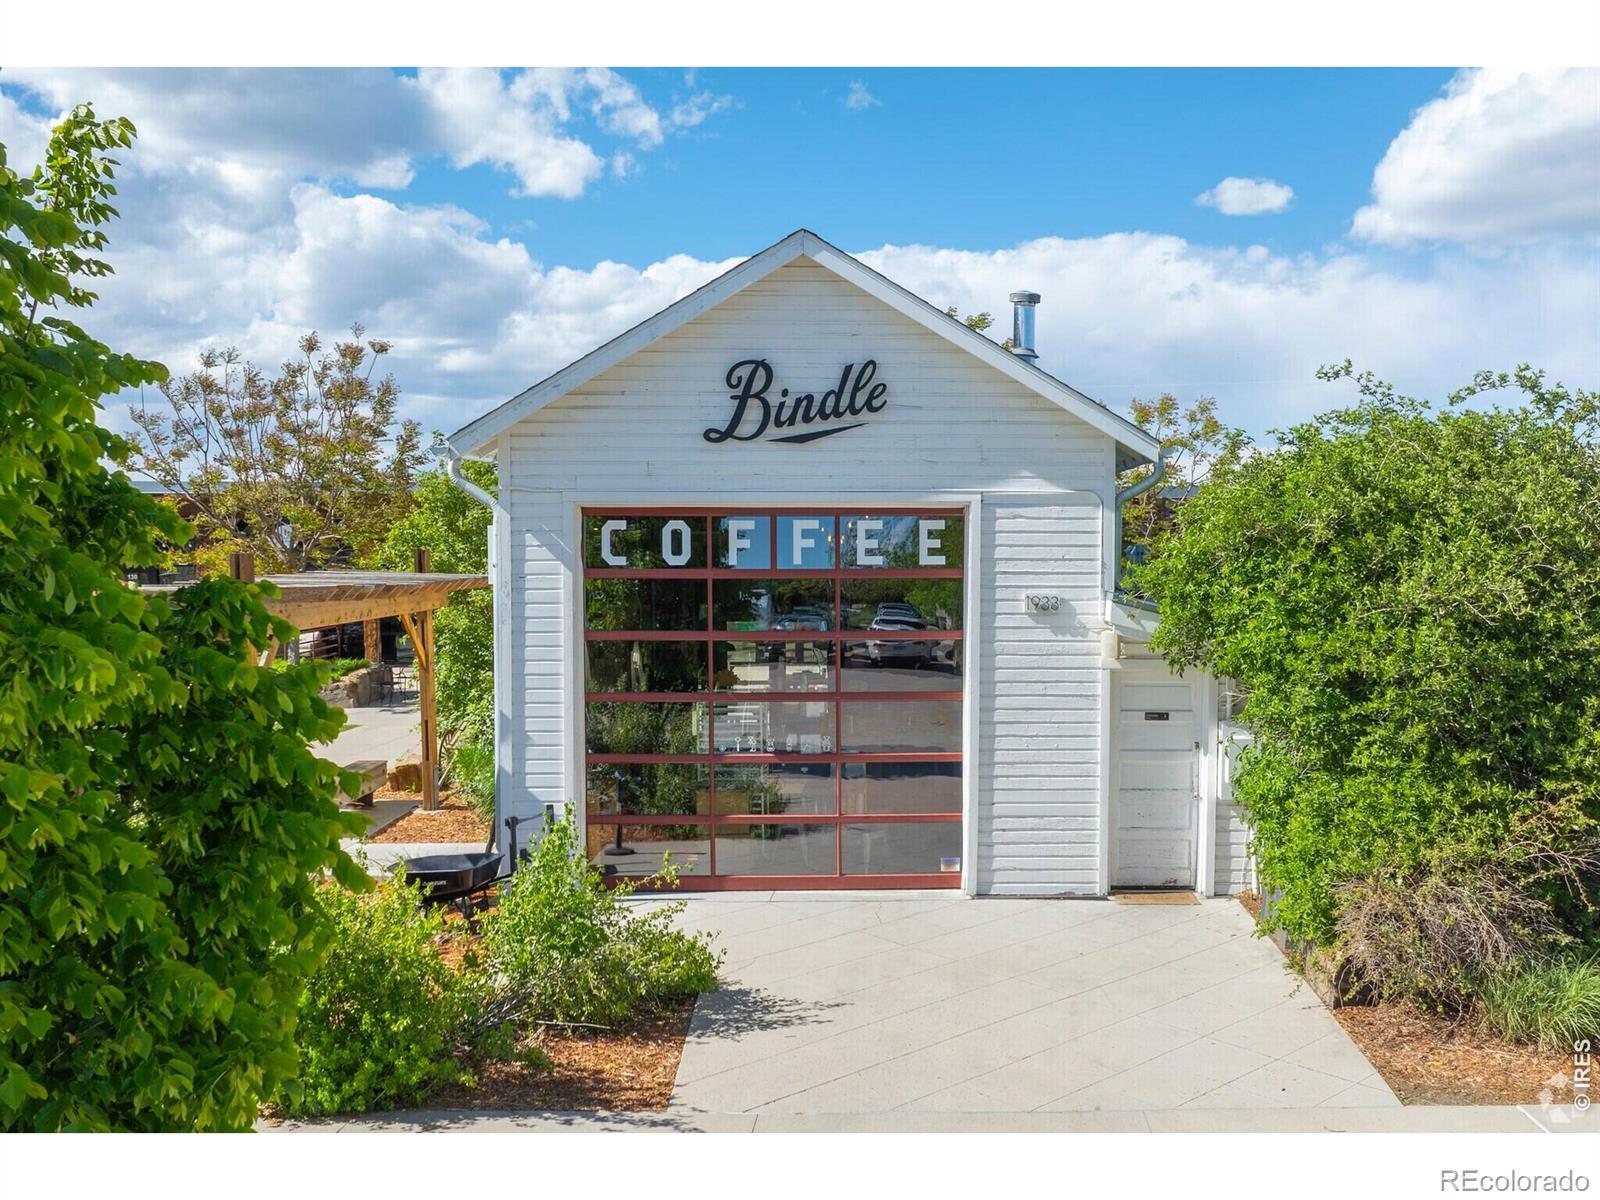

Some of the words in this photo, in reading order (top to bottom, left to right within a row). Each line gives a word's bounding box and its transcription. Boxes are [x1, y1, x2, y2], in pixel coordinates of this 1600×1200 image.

[703, 358, 887, 443] Bindle
[601, 519, 945, 566] COFFEE
[1025, 595, 1060, 611] 1933
